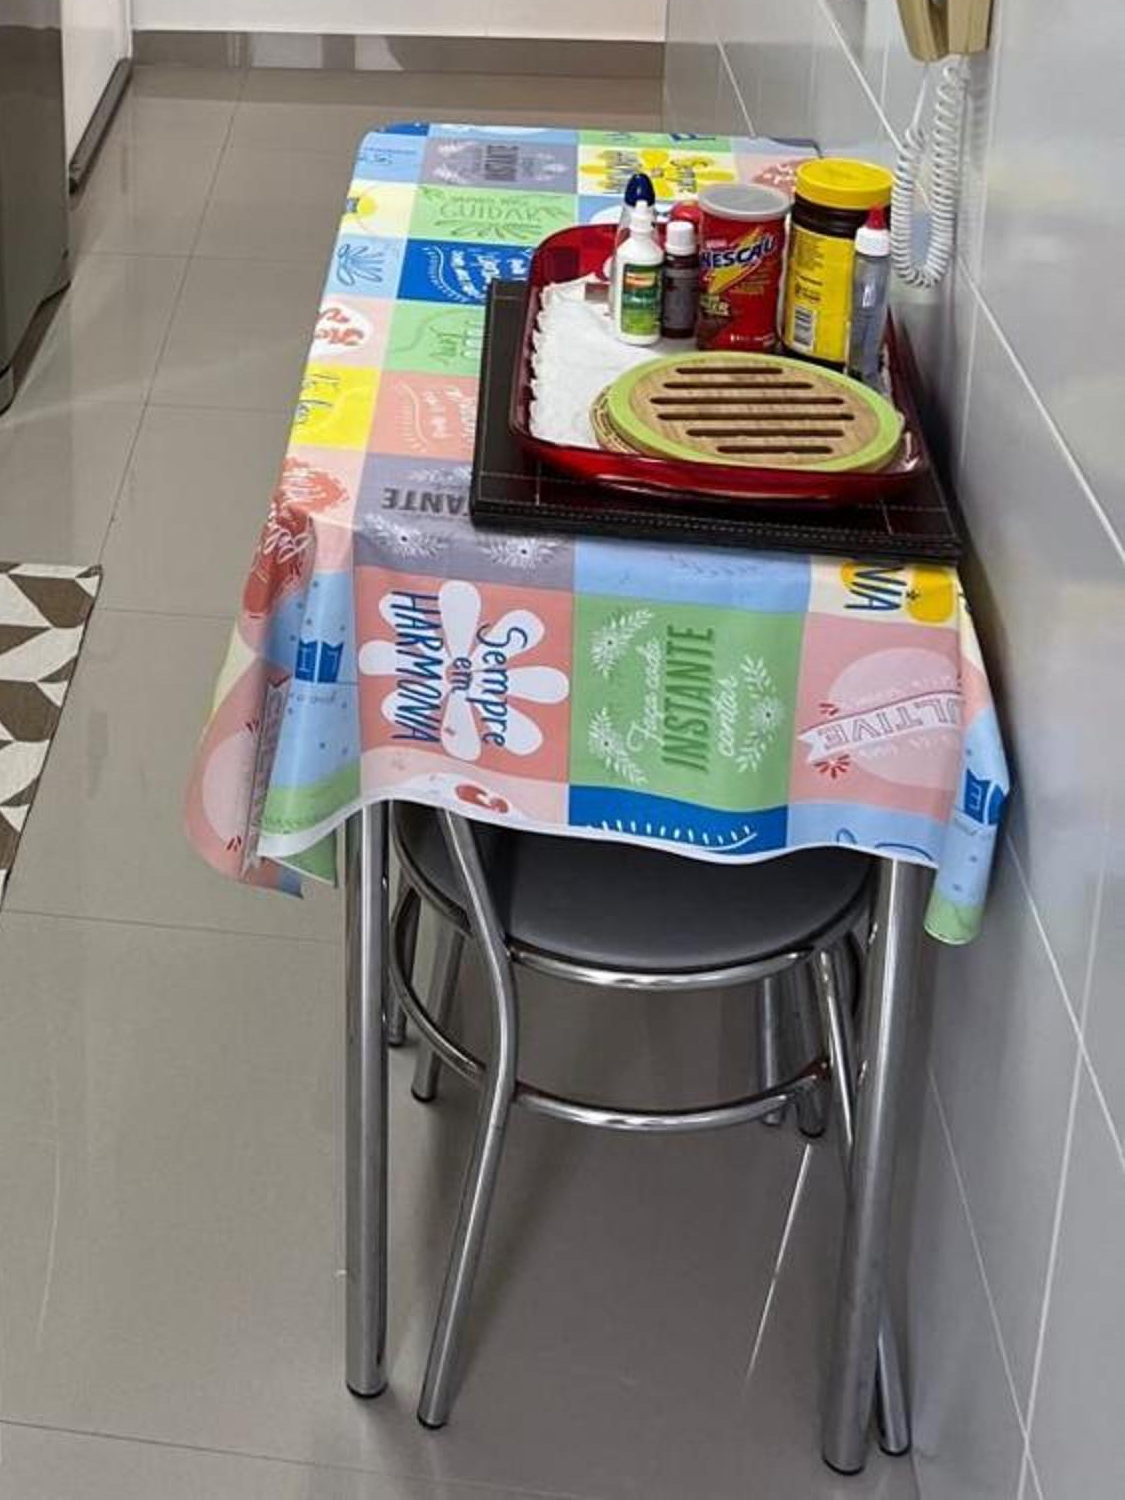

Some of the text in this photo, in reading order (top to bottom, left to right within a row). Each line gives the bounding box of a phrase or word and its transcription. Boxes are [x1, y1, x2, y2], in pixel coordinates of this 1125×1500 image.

[699, 233, 775, 269] NESCAU
[382, 486, 469, 517] ANTE
[390, 589, 444, 745] HARMONIA
[450, 655, 475, 694] em
[466, 622, 529, 749] Sempre
[661, 624, 715, 774] INSTANTE
[711, 673, 741, 757] contar
